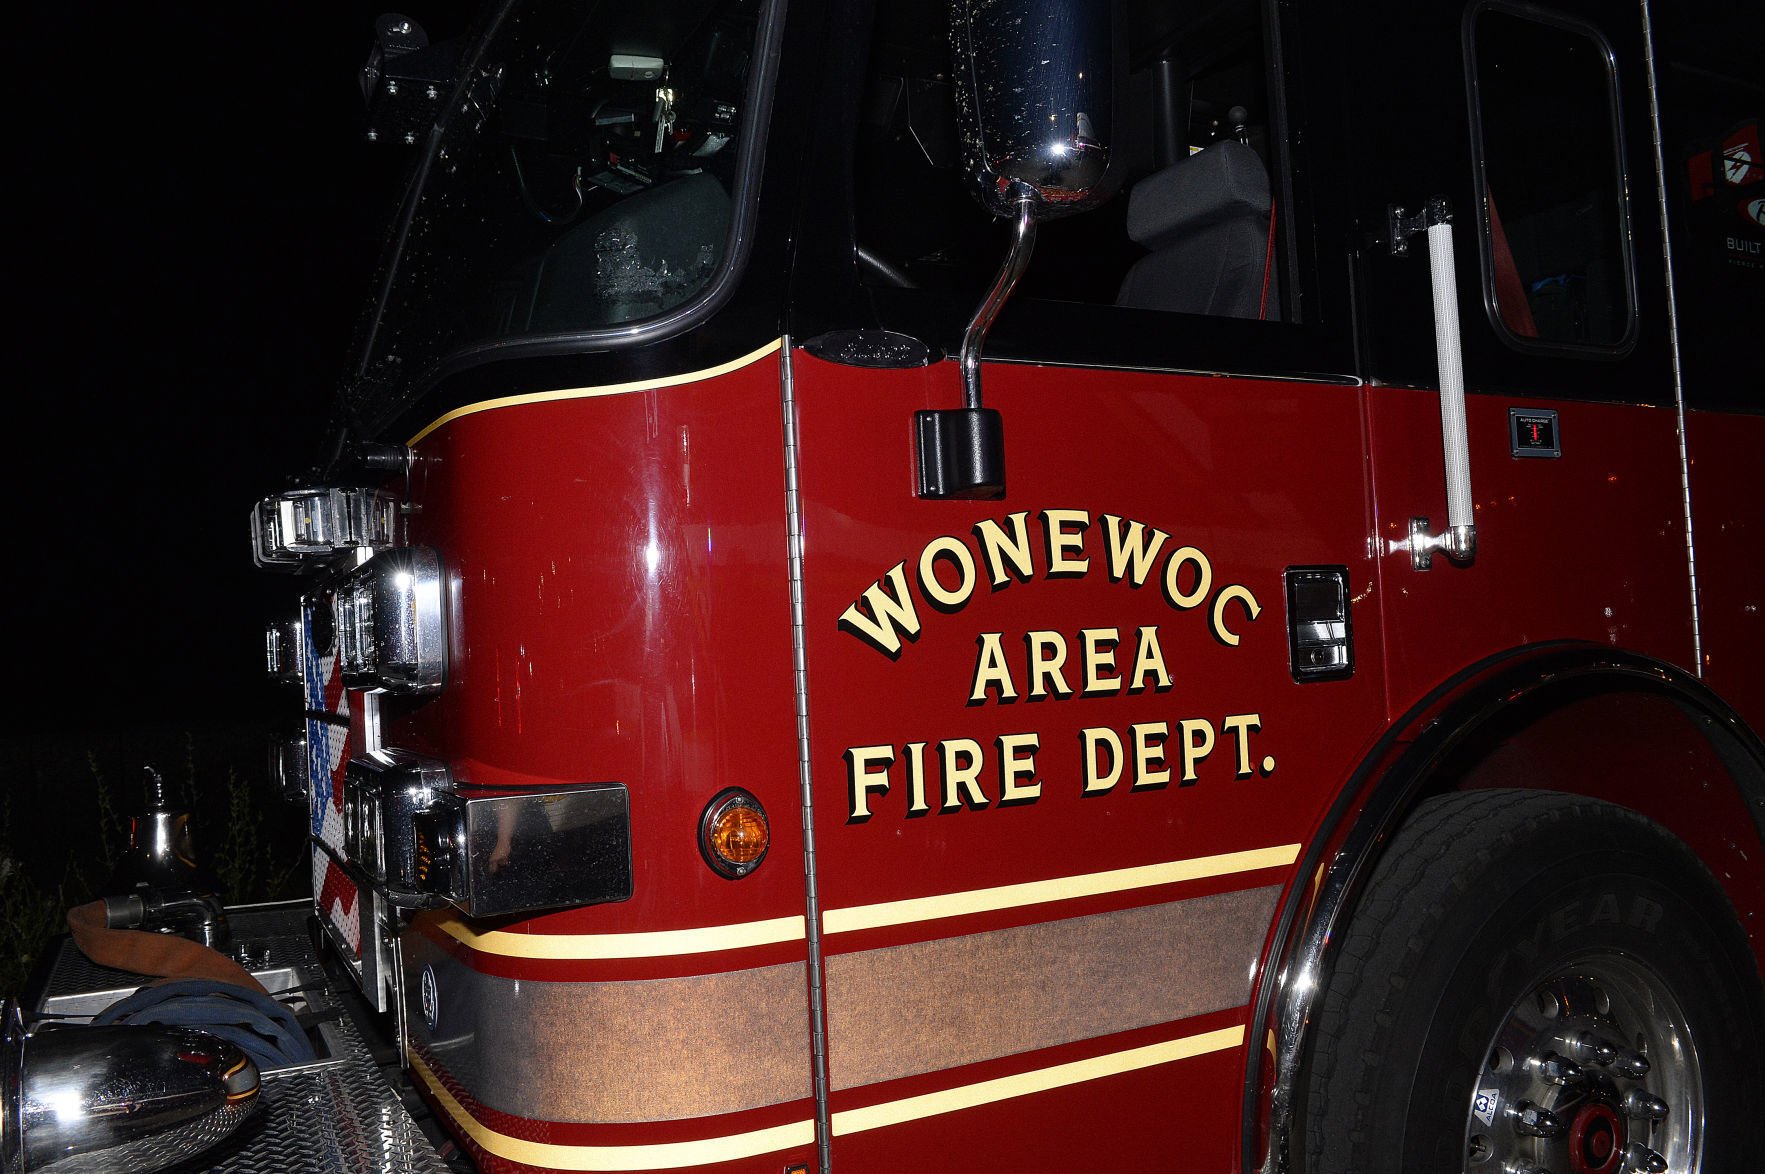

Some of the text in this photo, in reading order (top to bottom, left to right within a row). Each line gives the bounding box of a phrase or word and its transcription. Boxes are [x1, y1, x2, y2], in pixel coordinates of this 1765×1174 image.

[1726, 237, 1761, 254] BUILT
[838, 509, 1262, 662] WONEWOC
[966, 626, 1173, 707] AREA
[843, 713, 1276, 824] FIRE DEPT.
[1486, 1093, 1497, 1121] ALCOA
